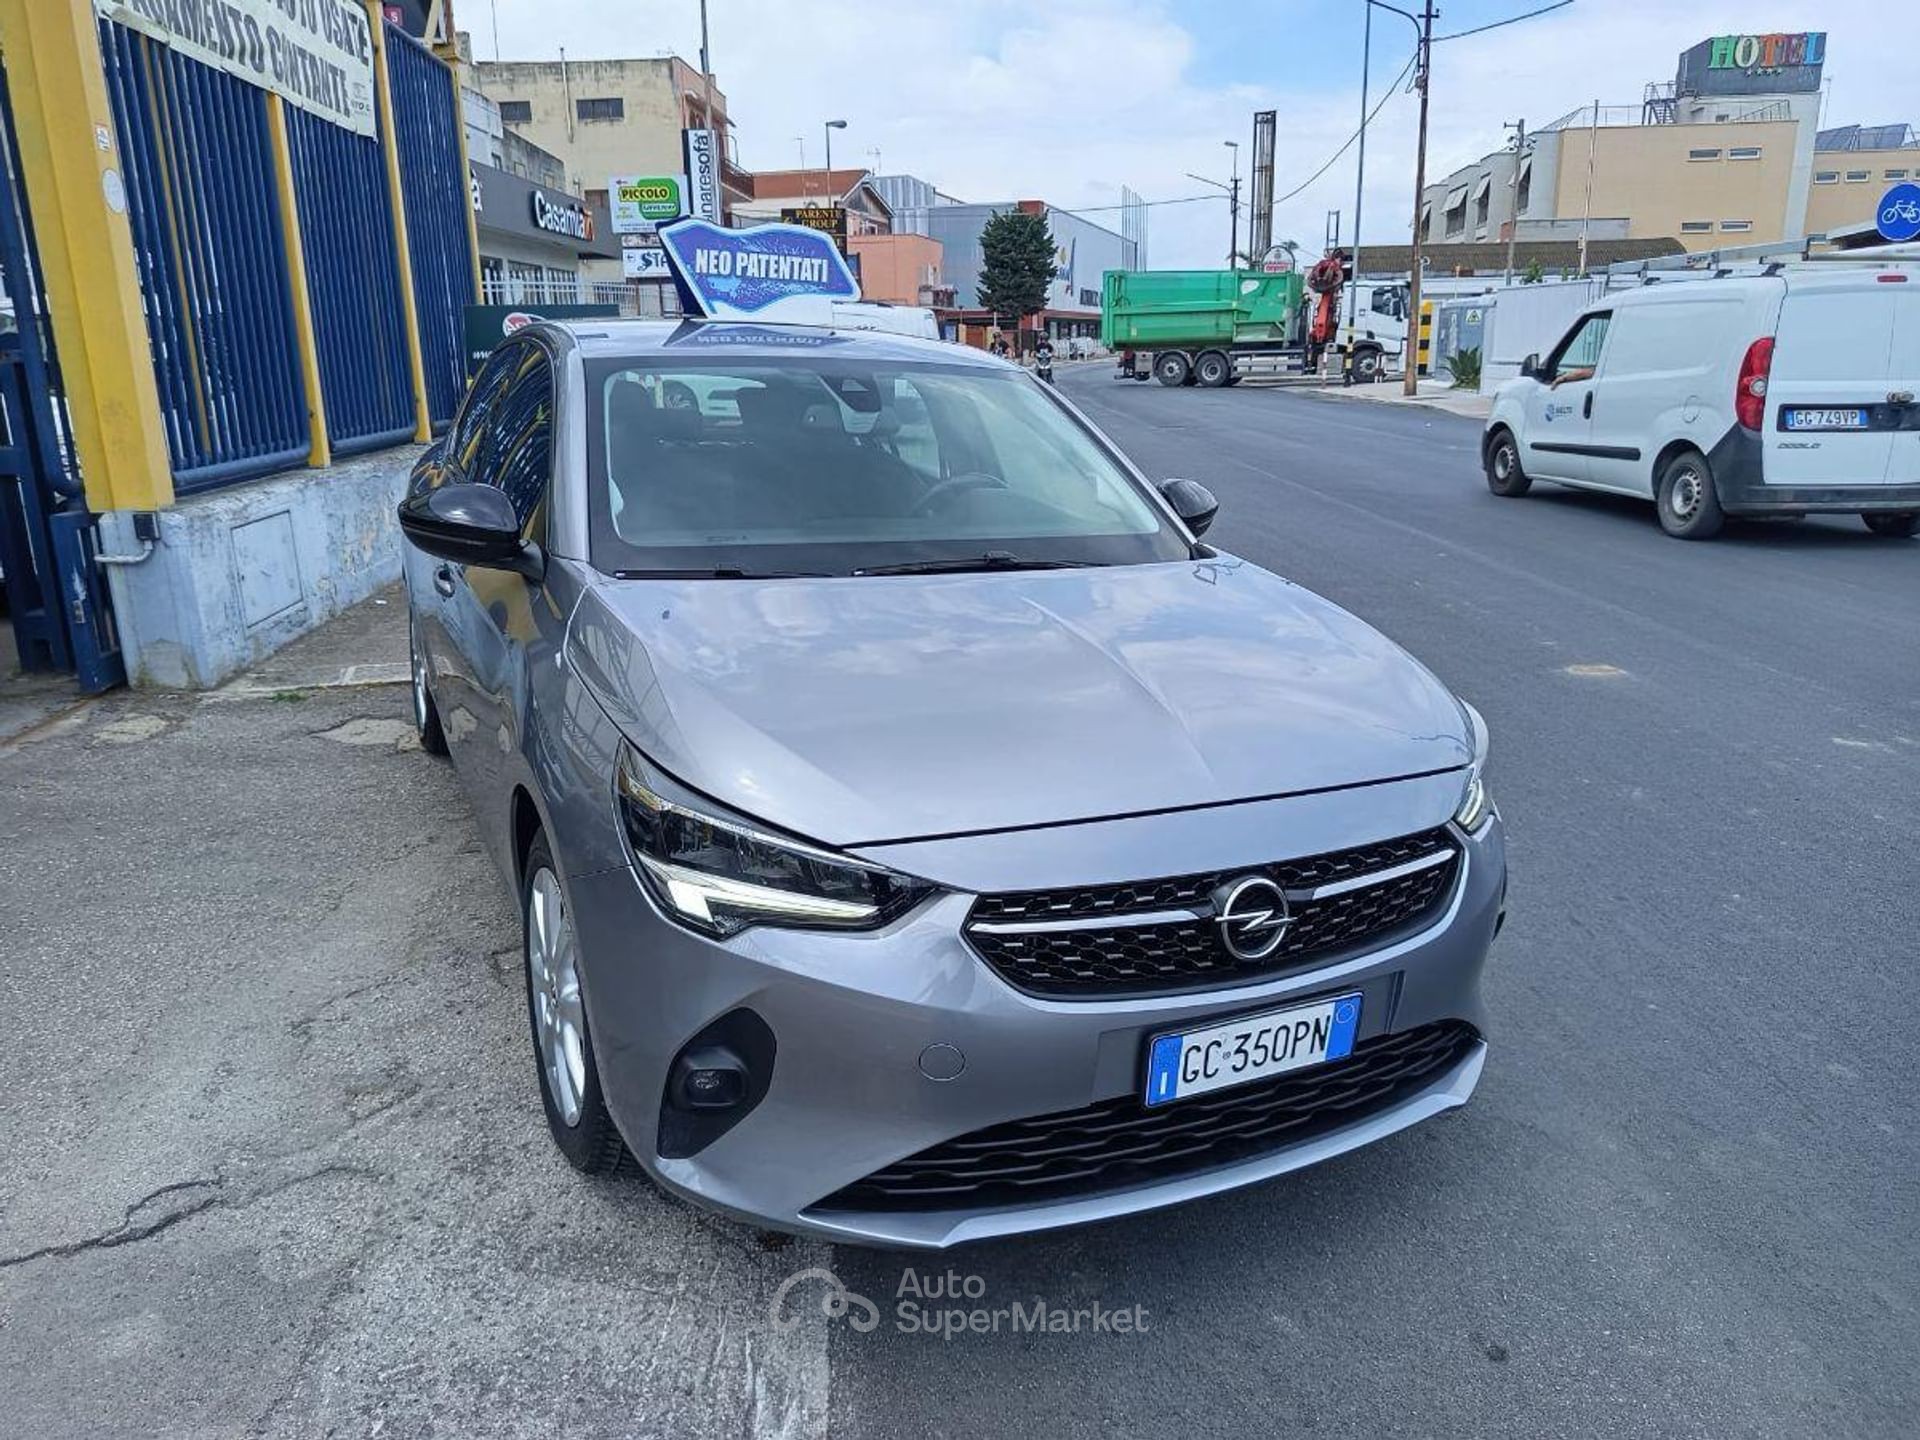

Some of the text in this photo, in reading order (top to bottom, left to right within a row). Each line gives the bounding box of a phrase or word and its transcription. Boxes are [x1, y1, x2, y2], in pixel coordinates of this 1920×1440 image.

[1707, 32, 1824, 69] HOTEL
[621, 187, 668, 199] PICCOLO
[535, 190, 586, 239] Casamia
[795, 209, 844, 219] PARENTE
[801, 219, 838, 229] GROUP
[695, 248, 829, 283] NEO PATENTATI
[1181, 1039, 1223, 1084] GC
[1231, 1014, 1332, 1073] 350PN
